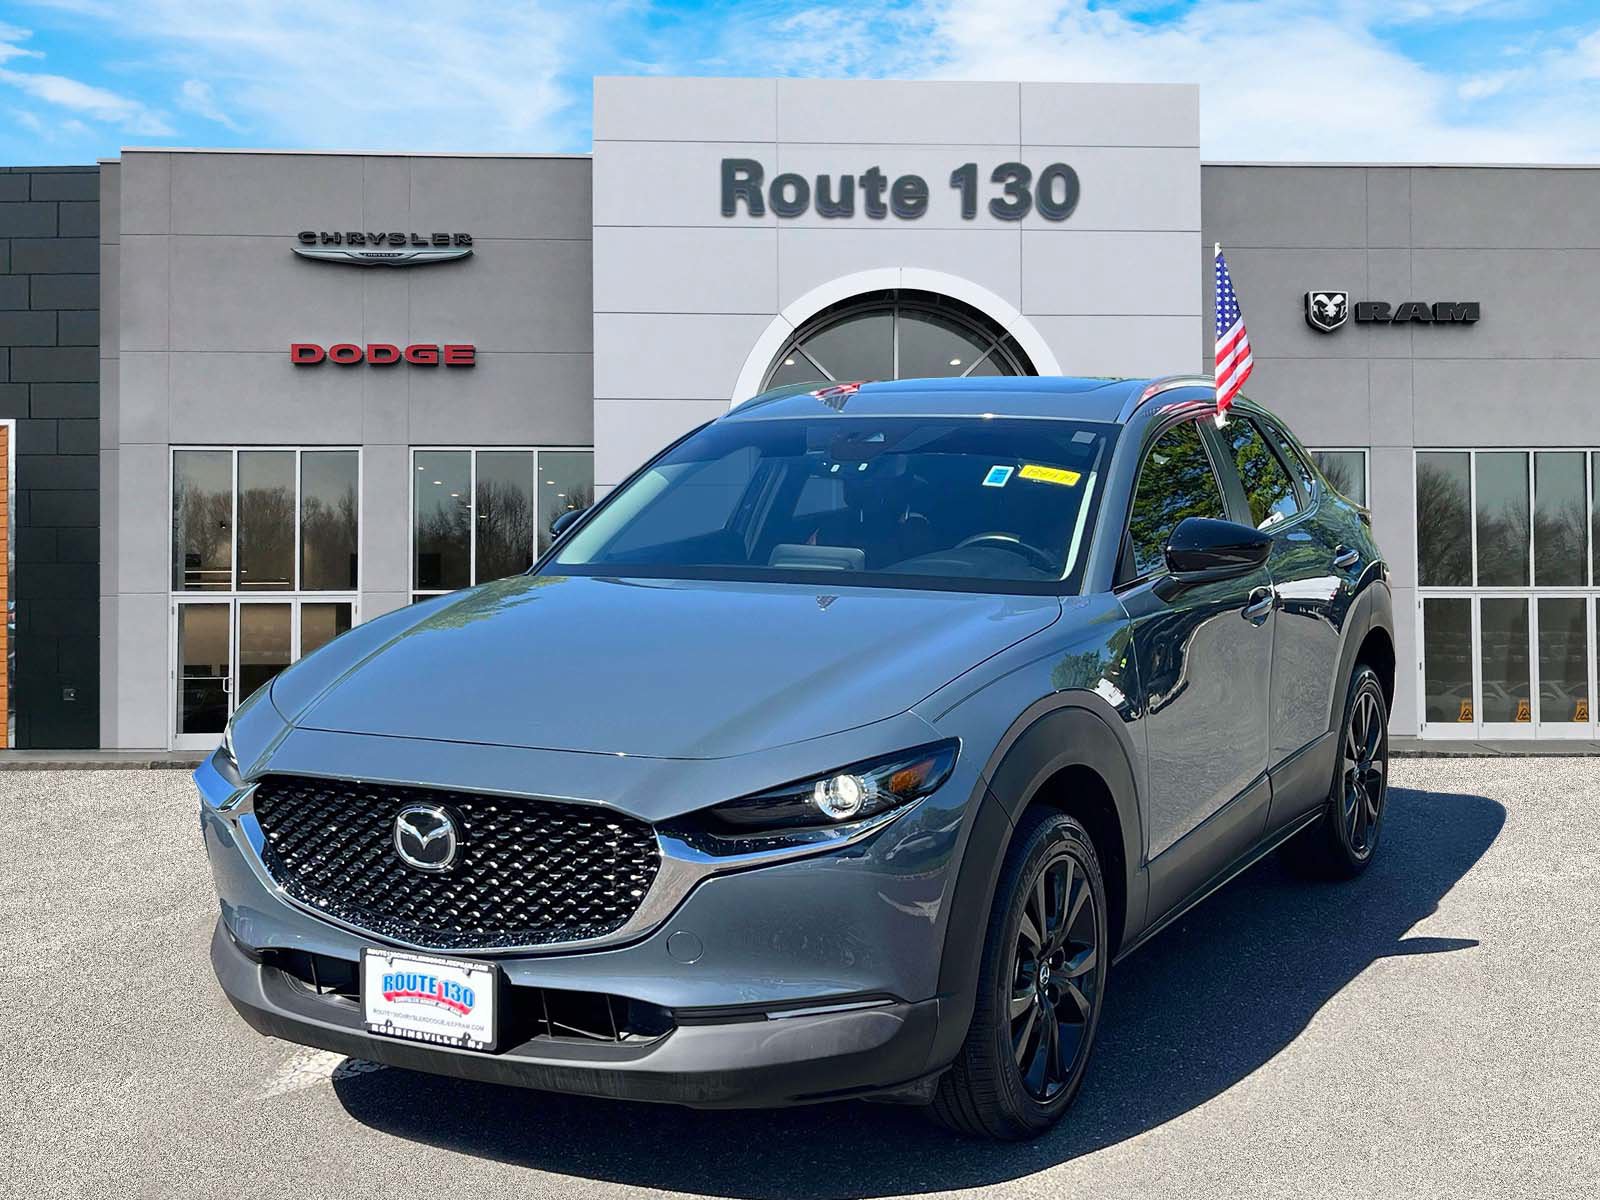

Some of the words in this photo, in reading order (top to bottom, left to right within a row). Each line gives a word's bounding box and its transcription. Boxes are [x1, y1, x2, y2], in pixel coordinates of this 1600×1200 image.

[721, 158, 929, 220] Route
[950, 162, 1081, 221] 130
[298, 231, 473, 246] CHRYSLER
[1354, 301, 1480, 324] RAM
[291, 343, 476, 366] DODGE
[383, 973, 438, 994] ROUTE
[442, 981, 474, 1008] 130
